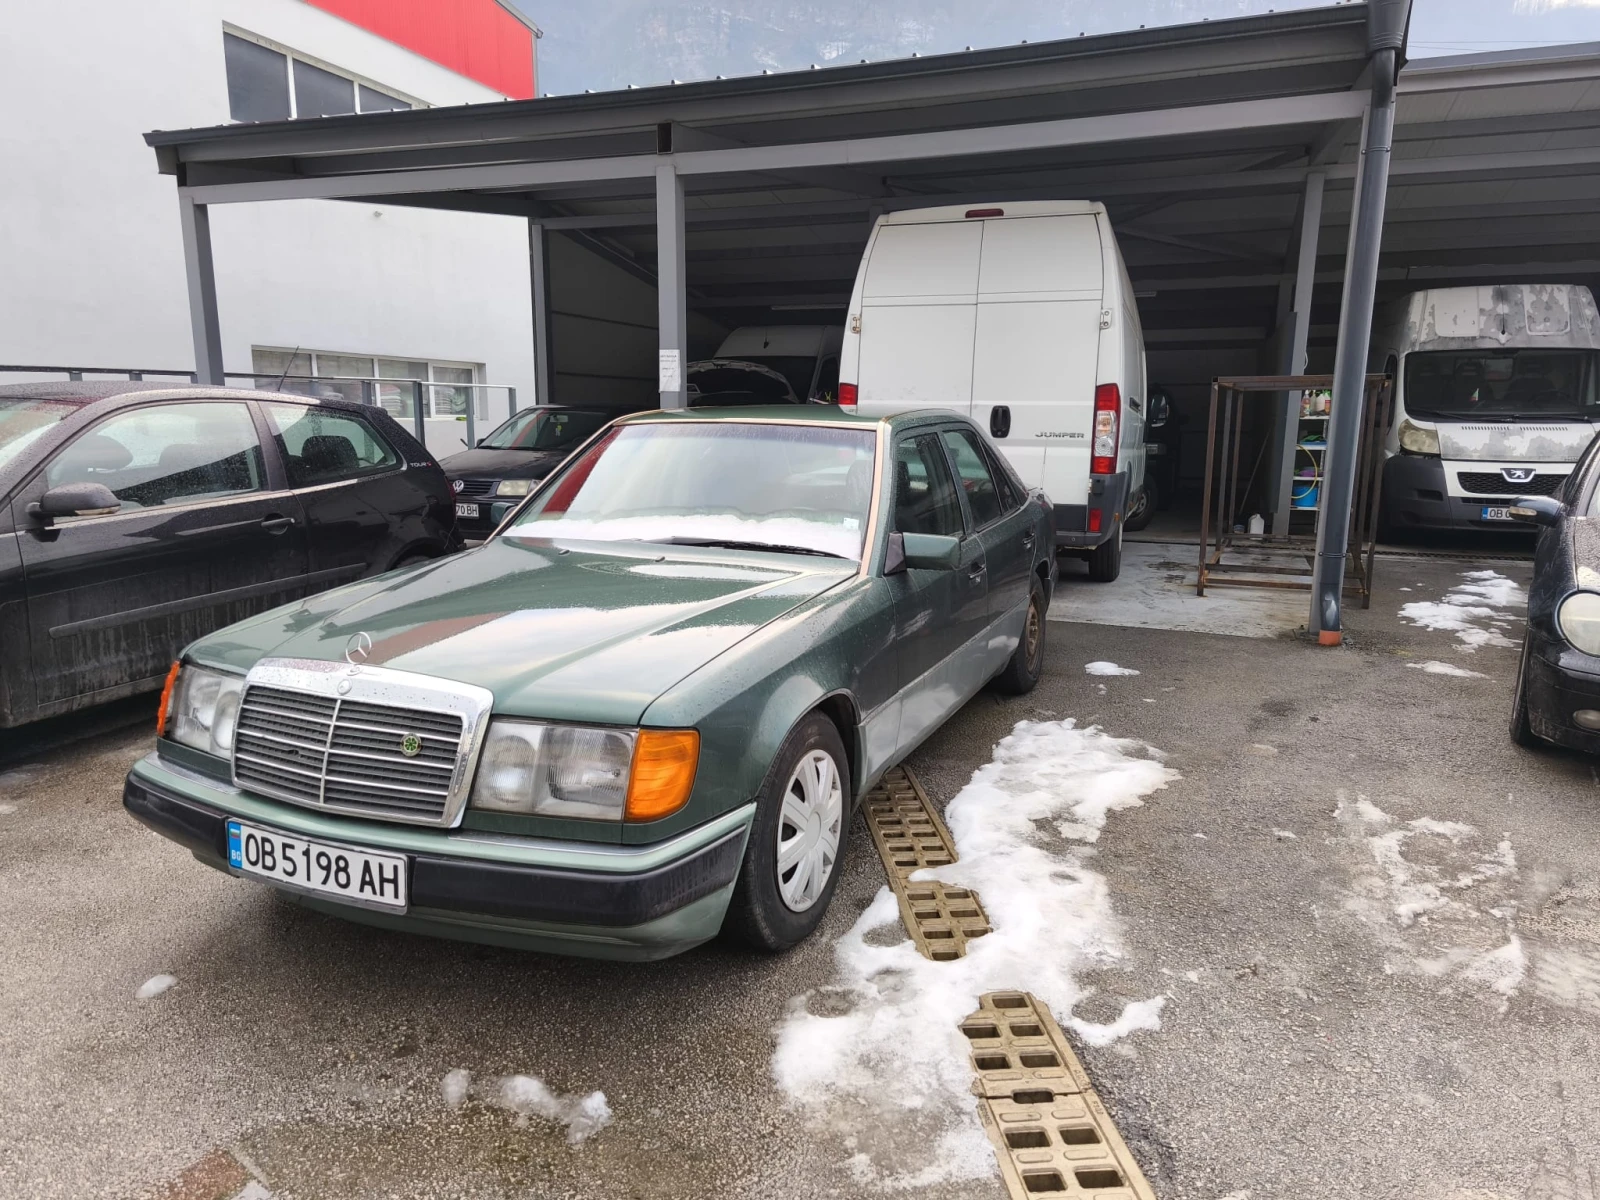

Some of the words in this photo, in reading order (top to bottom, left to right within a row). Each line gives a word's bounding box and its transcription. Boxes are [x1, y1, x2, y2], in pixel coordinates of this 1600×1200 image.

[1035, 431, 1085, 439] JUMPER
[466, 505, 478, 516] BH
[1489, 508, 1503, 518] OB
[231, 849, 241, 861] BG
[359, 859, 399, 900] AH
